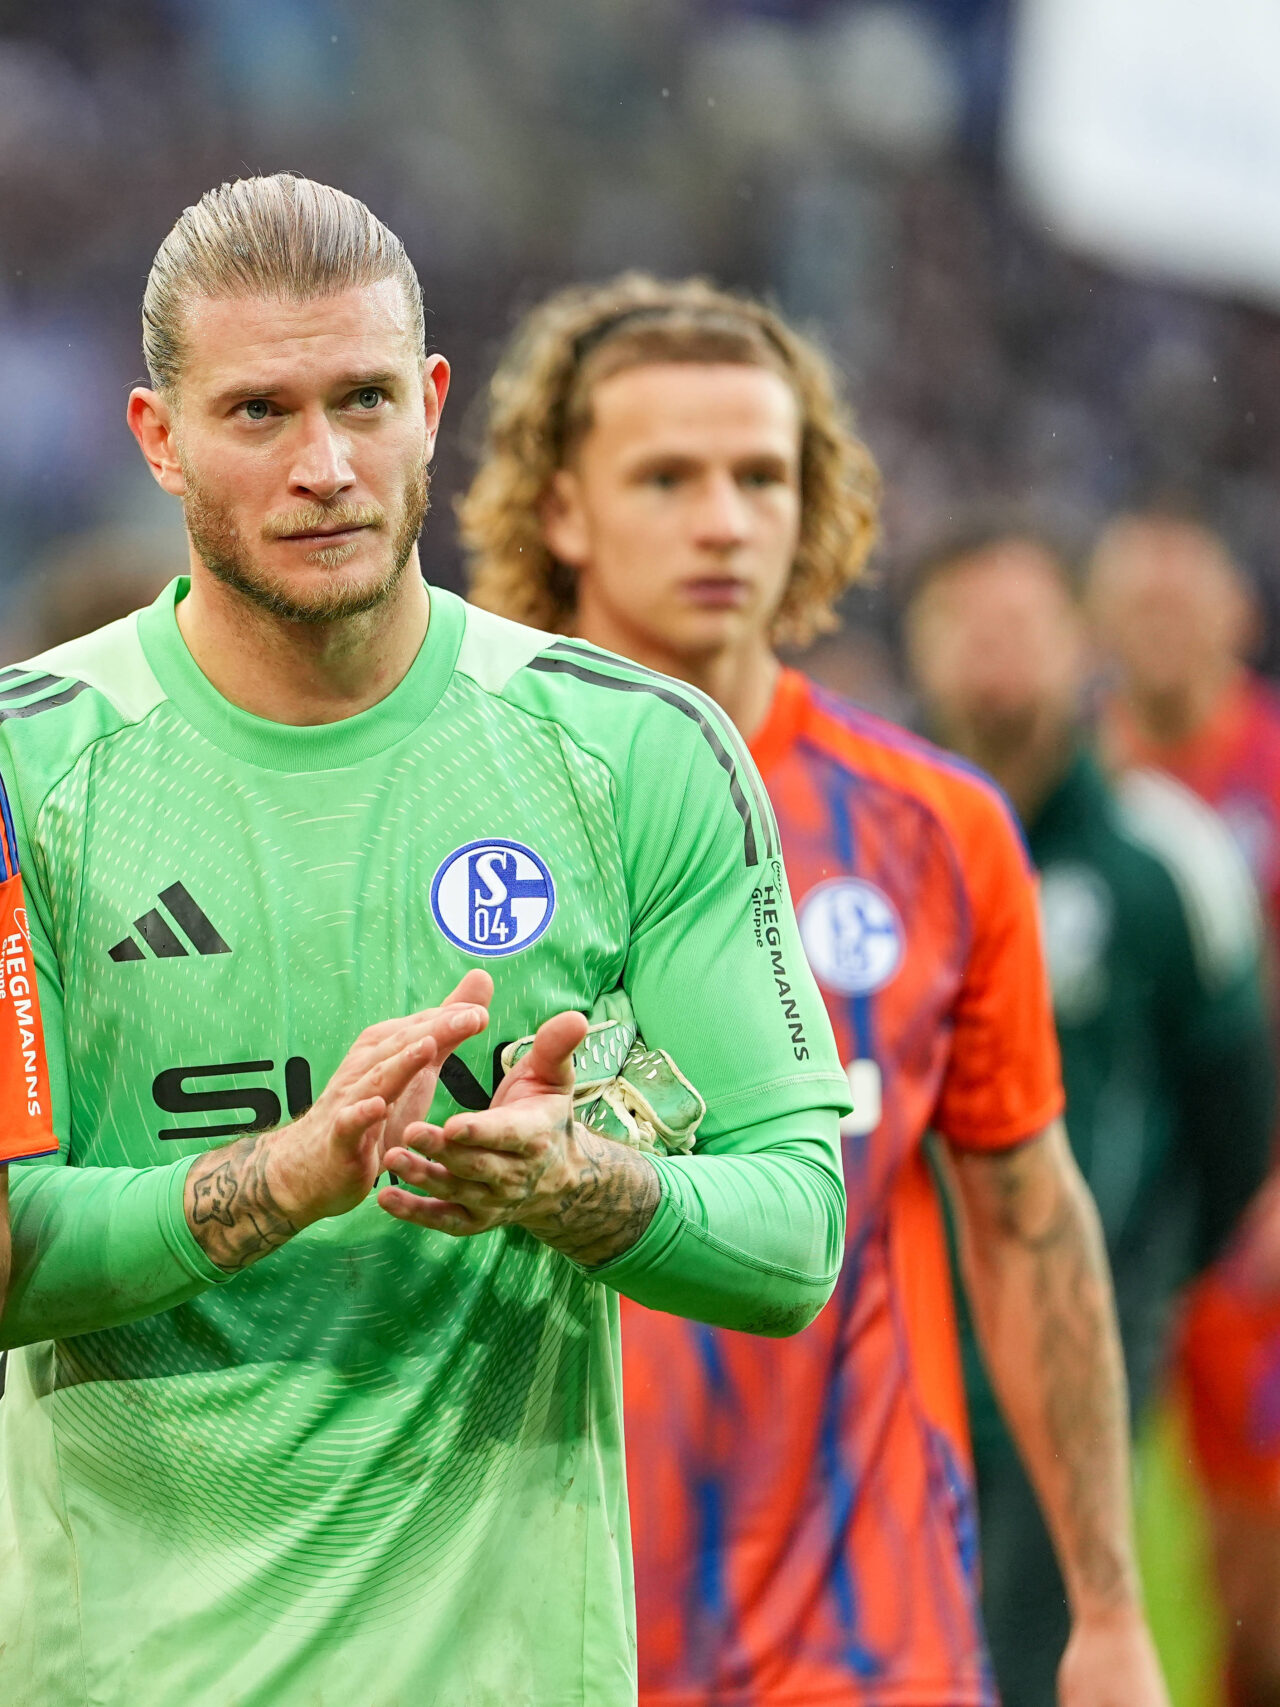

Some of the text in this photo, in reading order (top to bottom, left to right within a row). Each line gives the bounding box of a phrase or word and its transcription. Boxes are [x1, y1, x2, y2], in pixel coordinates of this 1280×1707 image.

[475, 908, 509, 942] 04
[751, 887, 763, 948] Gruppe
[763, 885, 809, 1061] HEGMANNS
[6, 932, 41, 1117] HEGMANNS
